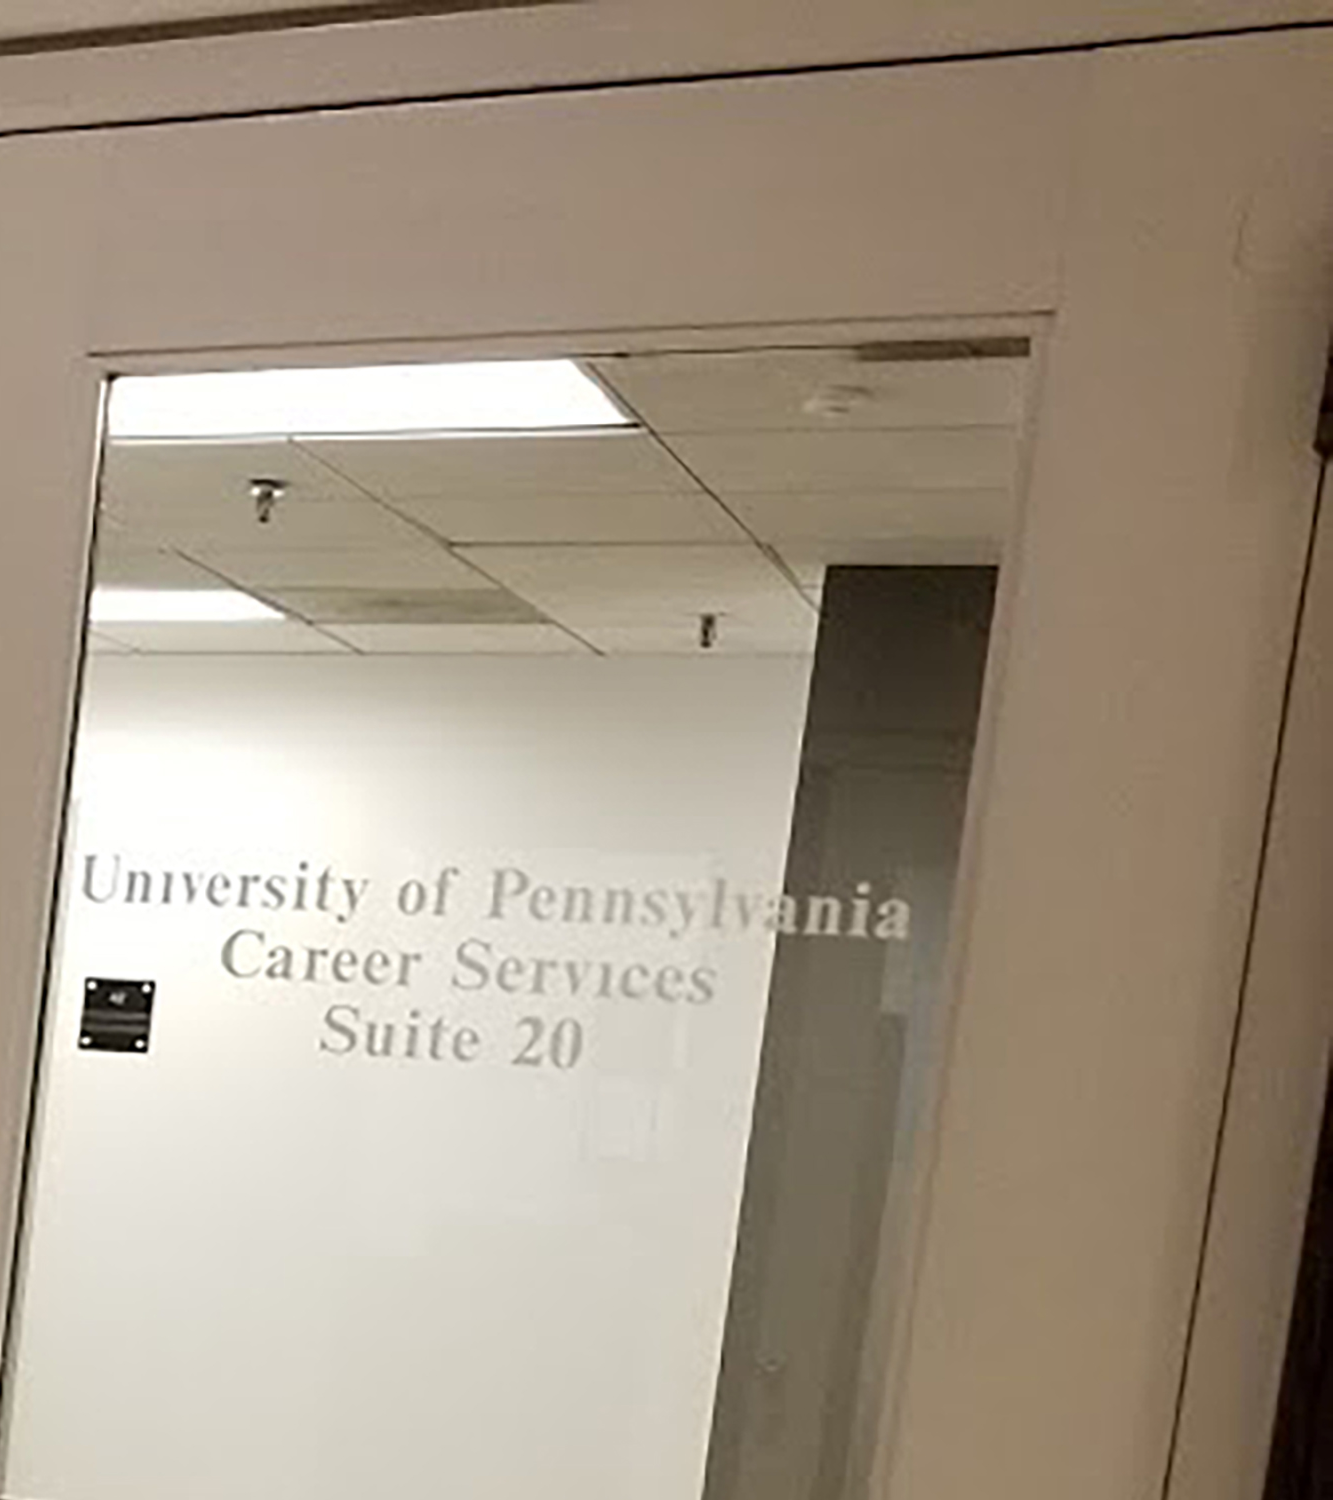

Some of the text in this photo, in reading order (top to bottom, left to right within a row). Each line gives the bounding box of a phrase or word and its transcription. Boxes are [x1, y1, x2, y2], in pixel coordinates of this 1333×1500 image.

[81, 853, 913, 940] University of Pennsylvania
[220, 928, 719, 1003] Career Services
[318, 1003, 585, 1070] Suite 20
